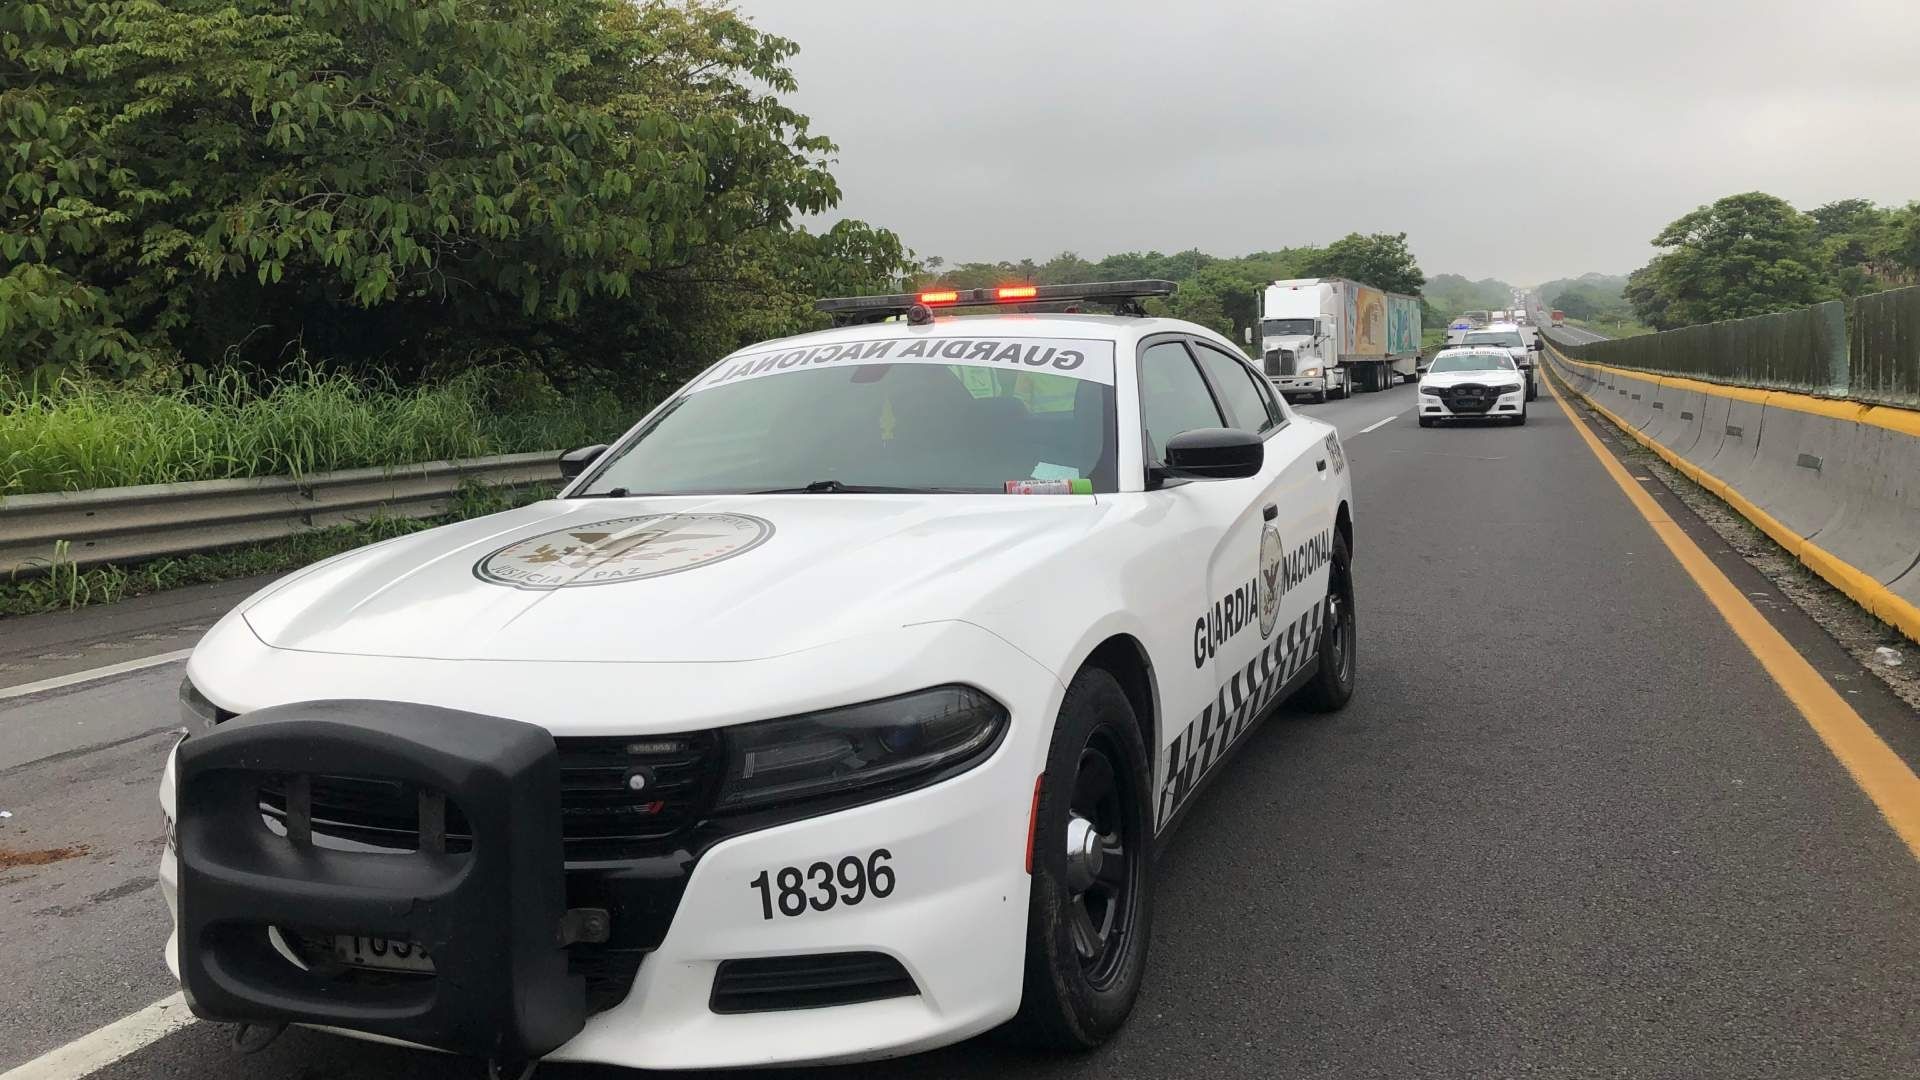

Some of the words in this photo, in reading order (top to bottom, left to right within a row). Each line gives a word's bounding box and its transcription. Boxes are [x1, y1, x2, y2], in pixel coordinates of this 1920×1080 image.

[594, 567, 641, 579] PAZ
[1194, 577, 1259, 669] GUARDIA
[1283, 528, 1331, 594] NACIONAL
[750, 848, 896, 920] 18396
